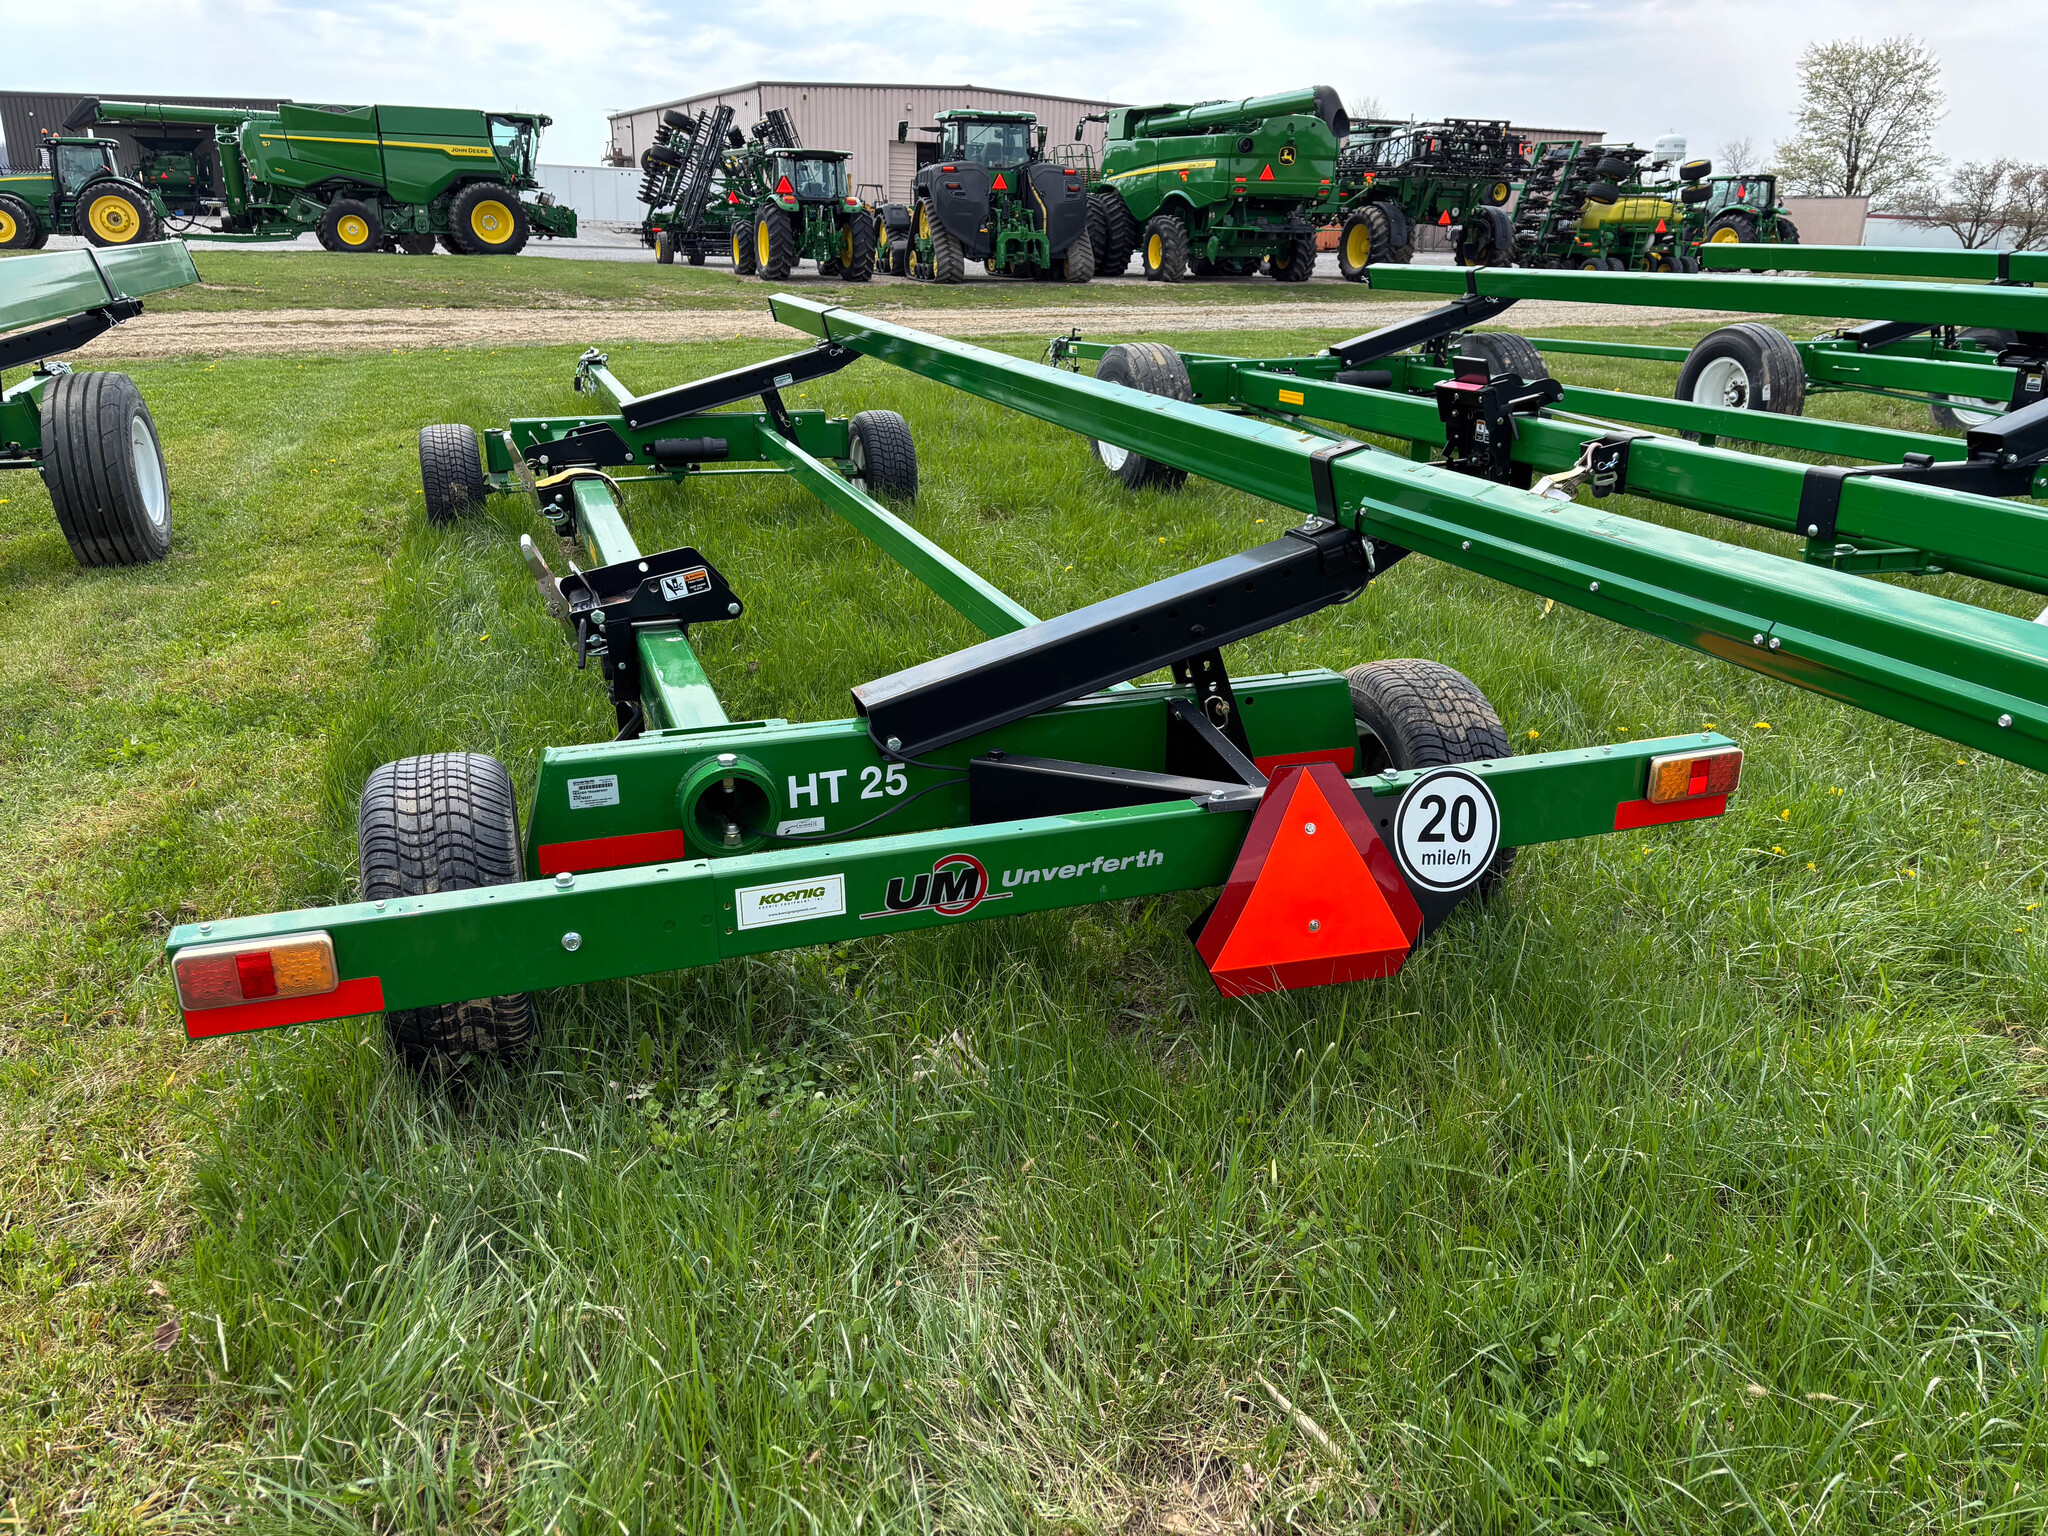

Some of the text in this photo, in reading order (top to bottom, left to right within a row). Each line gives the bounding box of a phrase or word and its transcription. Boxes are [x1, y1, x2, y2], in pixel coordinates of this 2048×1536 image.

[788, 763, 908, 809] HT 25
[1418, 795, 1477, 843] 20
[885, 850, 1164, 912] UM Unverferth
[1421, 849, 1471, 866] mile/h
